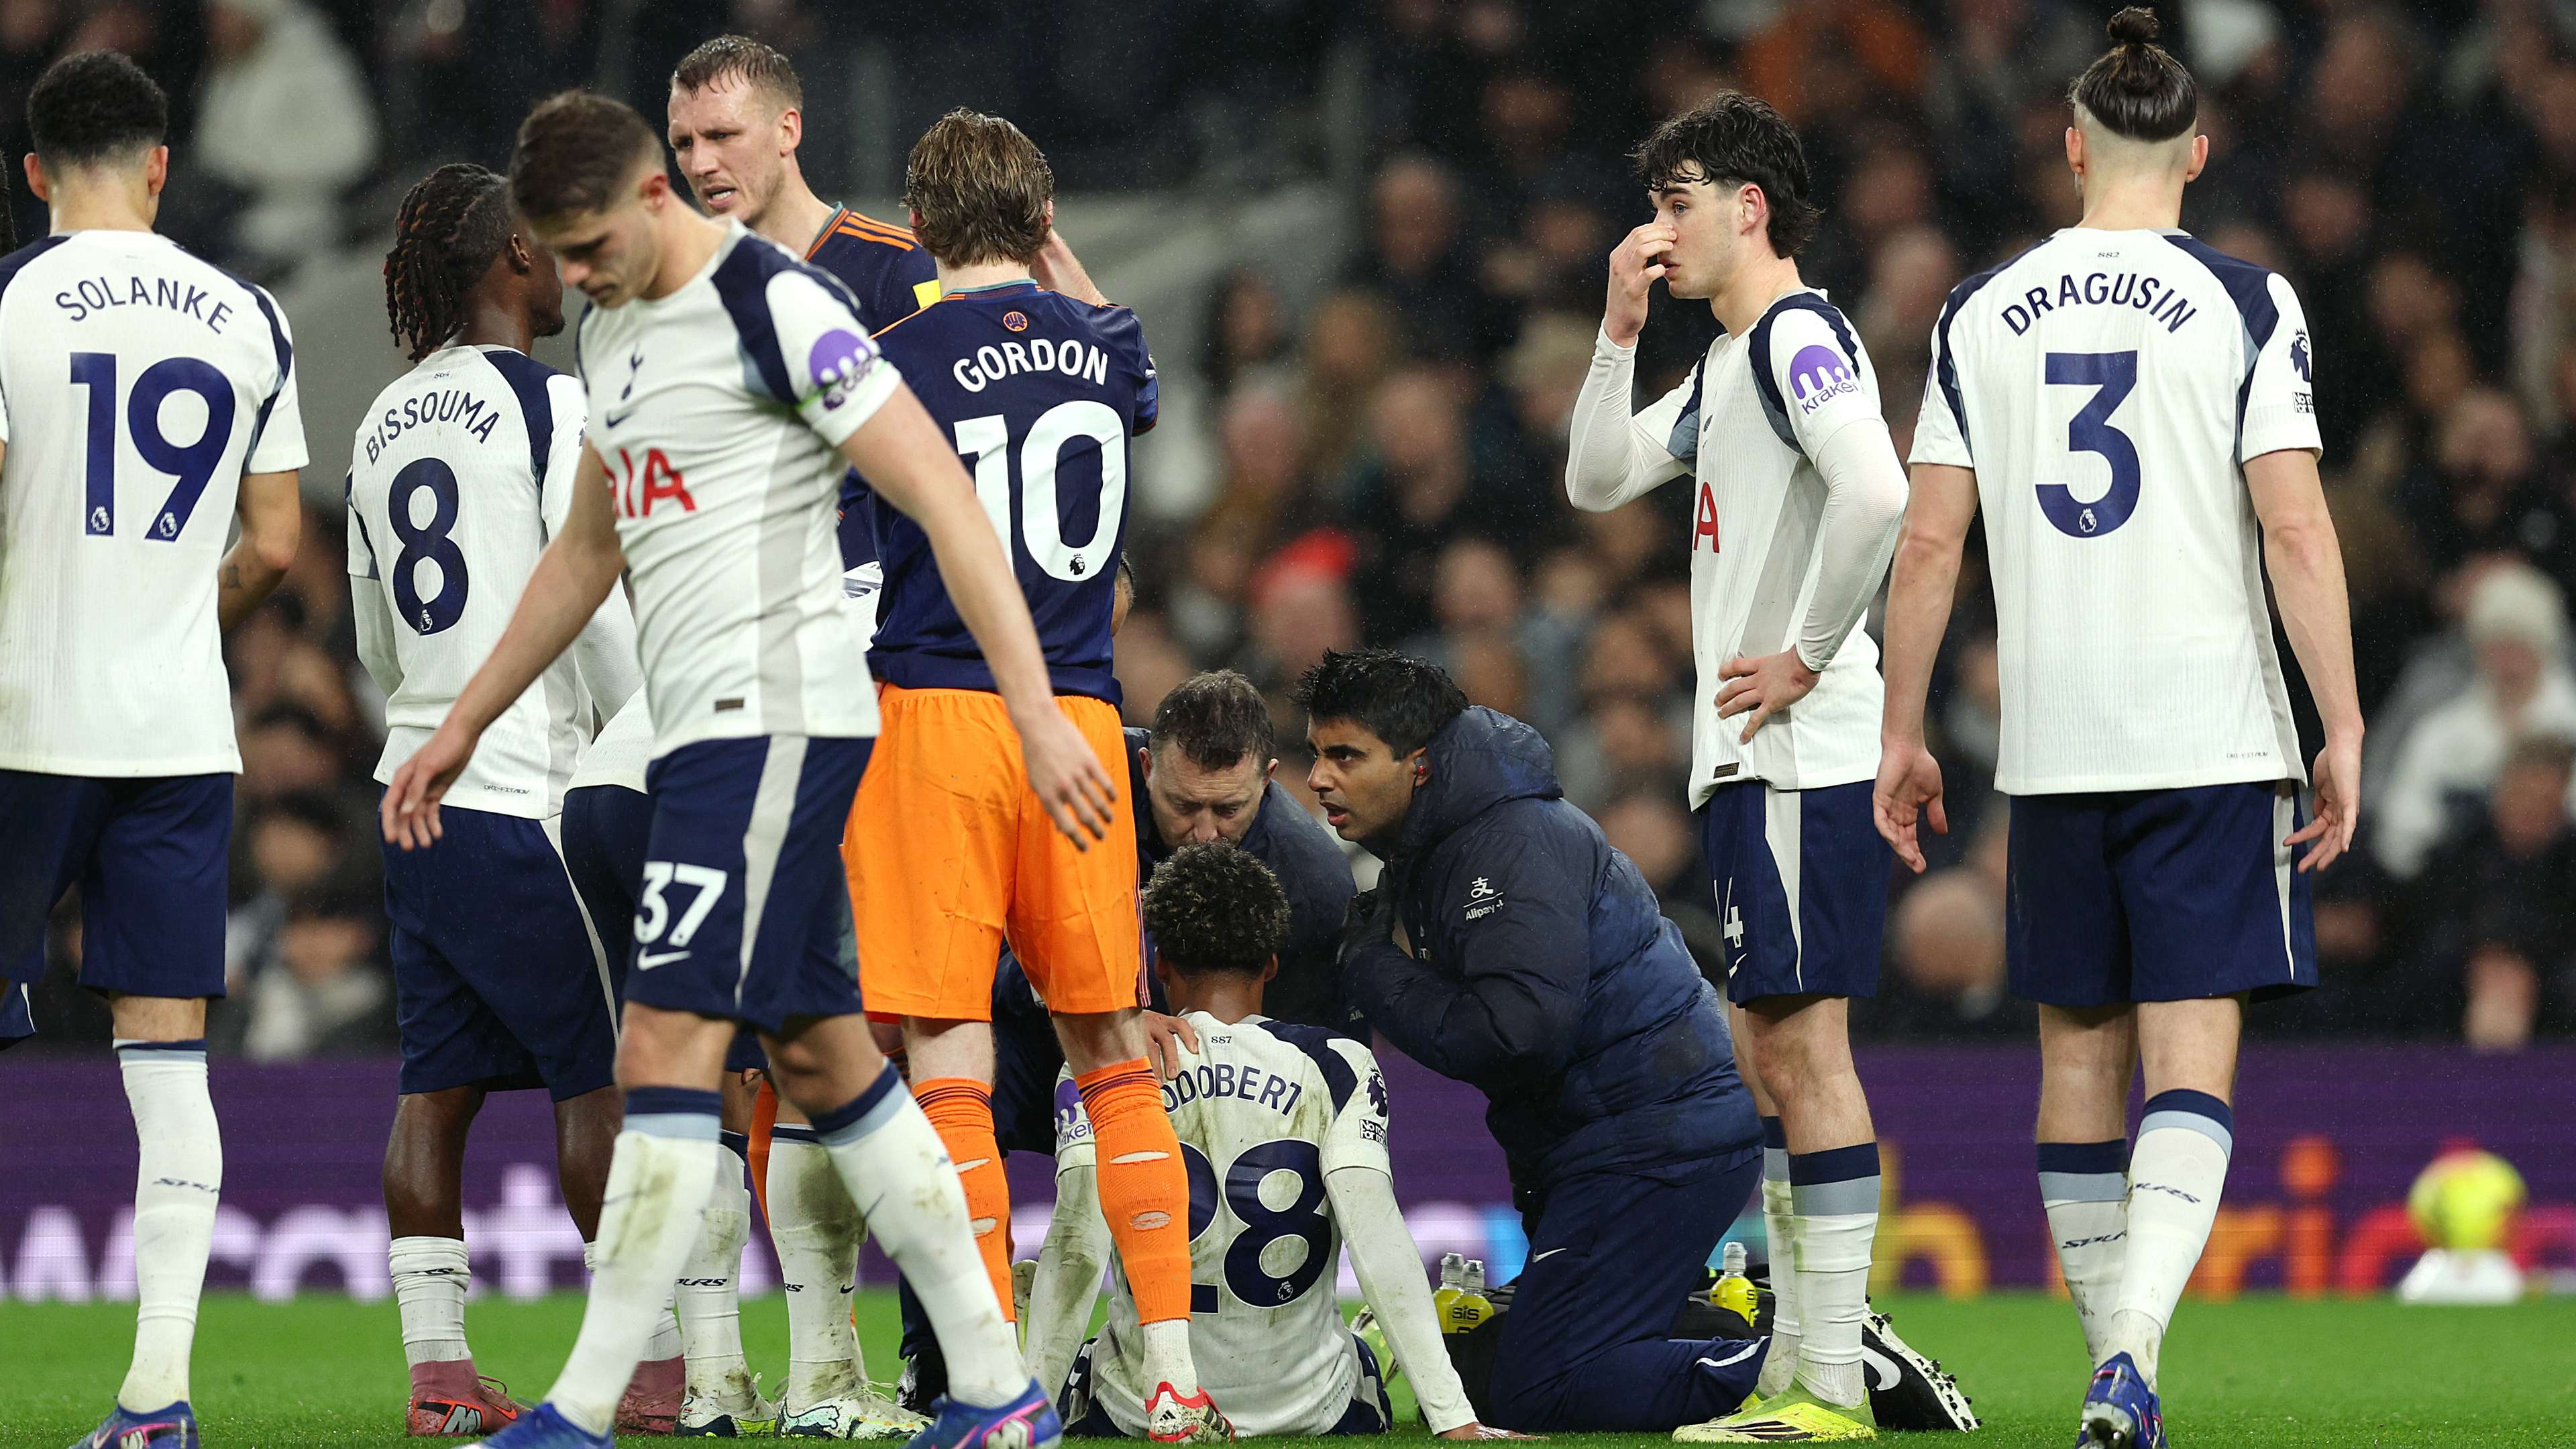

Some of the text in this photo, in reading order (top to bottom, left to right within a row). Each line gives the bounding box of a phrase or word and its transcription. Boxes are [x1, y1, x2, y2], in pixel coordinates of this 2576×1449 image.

[55, 276, 233, 335] SOLANKE
[2000, 272, 2198, 337] DRAGUSIN
[953, 338, 1109, 393] GORDON
[69, 352, 236, 543] 19
[365, 390, 502, 466] BISSOUMA
[2035, 349, 2141, 538] 3
[953, 400, 1126, 582] 10
[388, 457, 469, 636] 8
[633, 861, 729, 947] 37
[1211, 1036, 1232, 1044] 887
[1359, 1120, 1375, 1132] No
